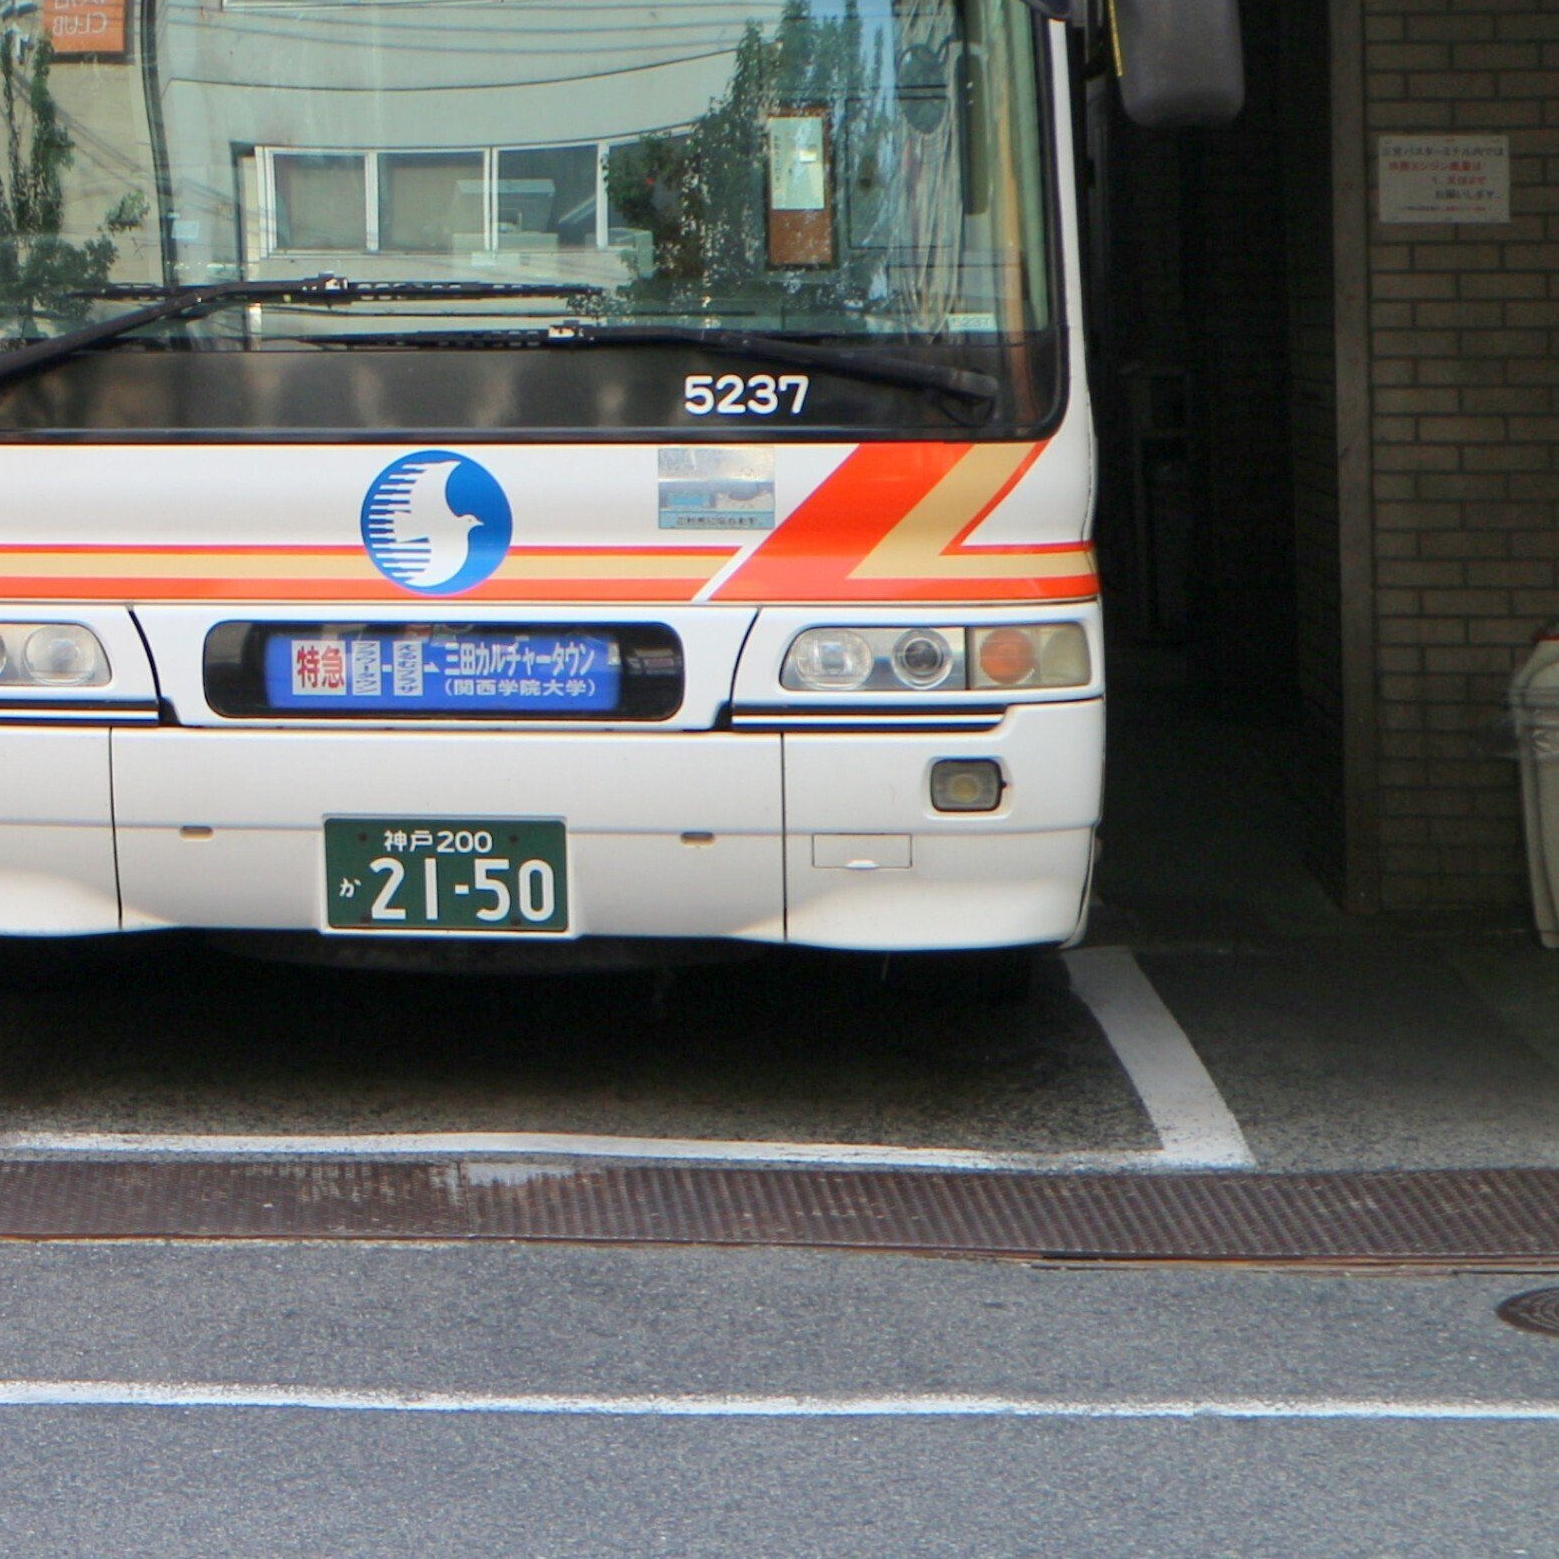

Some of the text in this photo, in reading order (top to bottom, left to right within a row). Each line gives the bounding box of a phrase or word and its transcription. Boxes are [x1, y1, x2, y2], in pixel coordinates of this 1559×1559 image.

[684, 374, 810, 415] 5237
[296, 644, 345, 690] 特急
[444, 643, 596, 678] 三田カルチャータウン
[339, 857, 556, 922] か 21-50
